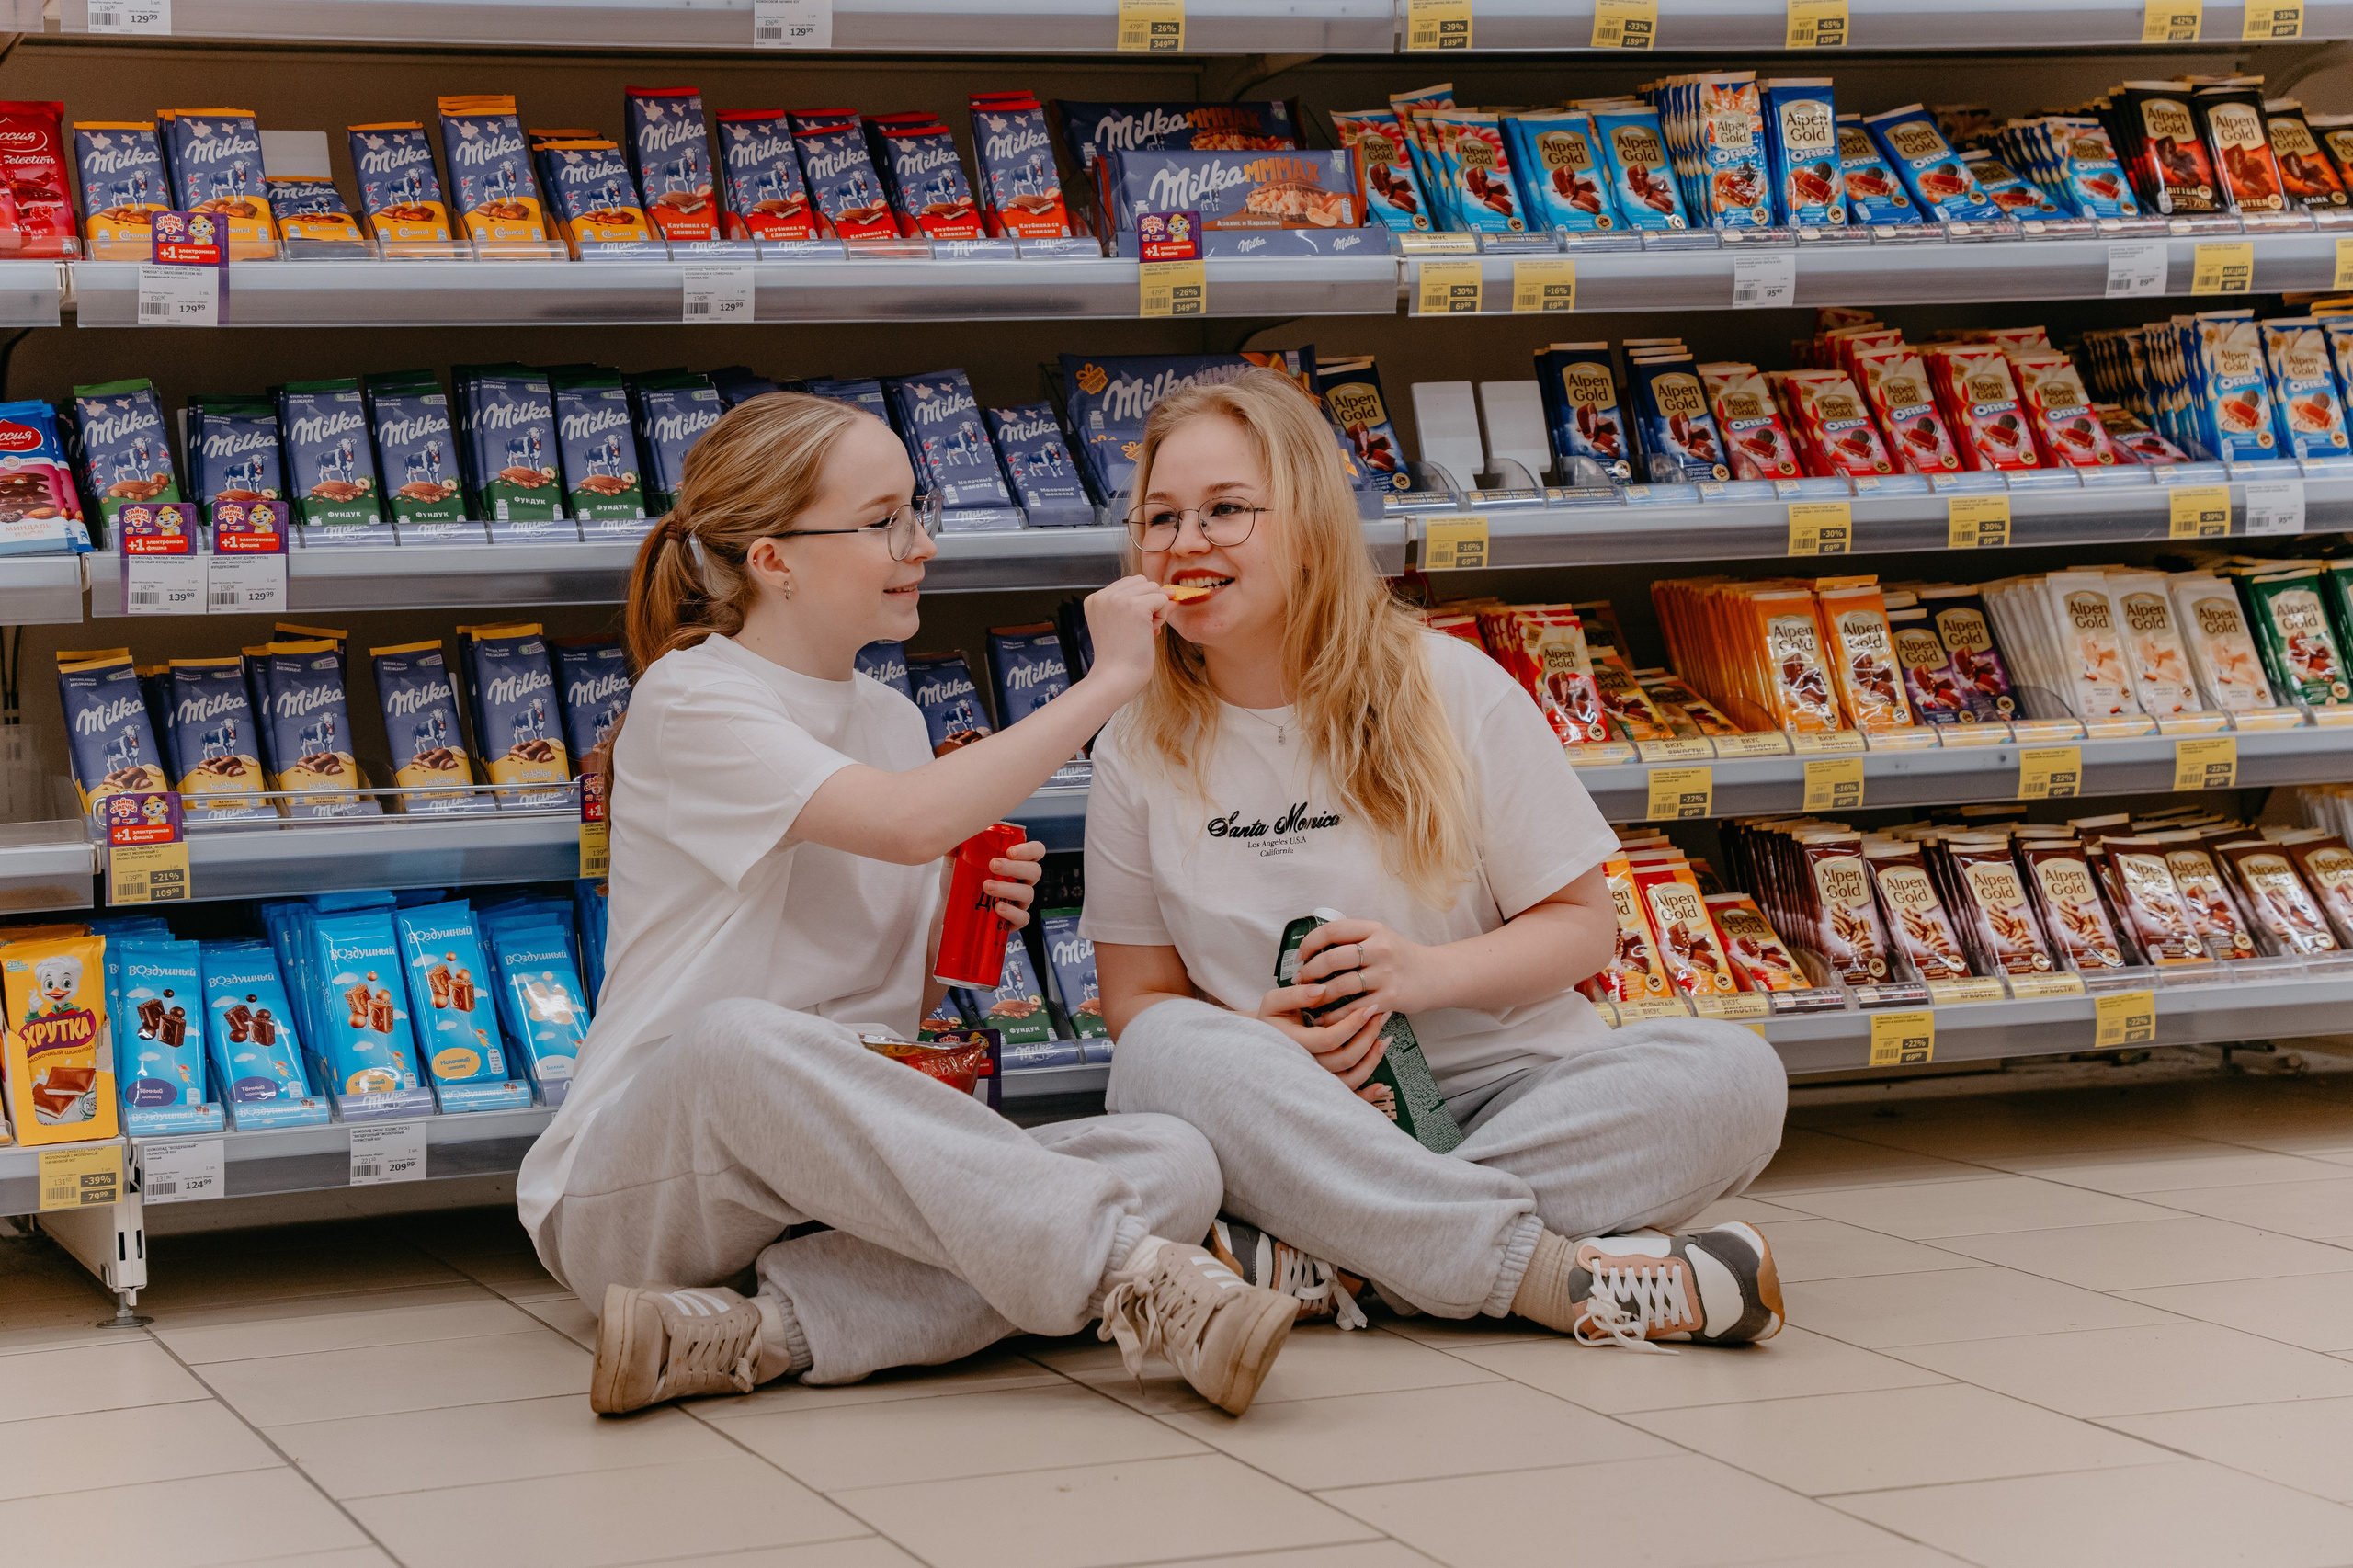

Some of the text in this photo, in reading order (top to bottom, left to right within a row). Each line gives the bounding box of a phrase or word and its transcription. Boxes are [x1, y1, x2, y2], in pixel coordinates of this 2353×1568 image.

[1785, 111, 1828, 129] Alpen
[2147, 109, 2187, 125] Alpen
[2215, 114, 2254, 129] Alpen
[639, 119, 707, 152] Milka
[1095, 108, 1190, 151] Milka
[1790, 127, 1826, 142] Gold
[1893, 128, 1933, 143] Alpen
[2154, 122, 2187, 135] Gold
[2222, 127, 2254, 142] Gold
[455, 135, 524, 165] Milka
[985, 130, 1050, 160] Milka
[1364, 139, 1393, 154] Alpen
[1542, 139, 1586, 156] Alpen
[1616, 134, 1658, 150] Alpen
[1904, 140, 1938, 153] Gold
[185, 137, 258, 164] Milka
[729, 137, 795, 167] Milka
[1368, 150, 1394, 162] Gold
[1548, 151, 1585, 165] Gold
[1623, 147, 1658, 164] Gold
[1715, 147, 1758, 163] OREO
[1791, 147, 1833, 162] OREO
[84, 146, 160, 173] Milka
[361, 146, 431, 174] Milka
[807, 148, 870, 179] Milka
[896, 149, 960, 176] Milka
[1911, 151, 1950, 168] OREO
[561, 161, 627, 183] Milka
[1149, 158, 1246, 210] Milka
[1238, 235, 1267, 252] Milka
[2221, 351, 2249, 361] Alpen
[2223, 361, 2248, 371] Gold
[1569, 373, 1608, 390] Alpen
[1972, 382, 2002, 393] Alpen
[2221, 376, 2260, 390] OREO
[2290, 378, 2330, 391] OREO
[1574, 387, 1608, 403] Gold
[1659, 383, 1699, 400] Alpen
[1976, 390, 2003, 401] Gold
[915, 395, 975, 424] Milka
[1334, 392, 1377, 412] Alpen
[1665, 394, 1699, 411] Gold
[1972, 402, 2017, 417] OREO
[482, 401, 551, 430] Milka
[1341, 404, 1377, 421] Gold
[1893, 404, 1931, 421] OREO
[85, 411, 158, 446] Milka
[292, 411, 365, 445] Milka
[379, 415, 449, 447] Milka
[561, 409, 630, 440] Milka
[998, 418, 1059, 441] Milka
[1730, 416, 1775, 431] OREO
[202, 432, 278, 458] Milka
[2071, 602, 2109, 615] Alpen
[2127, 604, 2165, 617] Alpen
[2199, 608, 2237, 622] Alpen
[1942, 619, 1982, 636] Alpen
[2075, 614, 2109, 629] Gold
[2132, 615, 2165, 630] Gold
[2205, 619, 2237, 634] Gold
[1775, 625, 1814, 641] Alpen
[1949, 632, 1983, 646] Gold
[1899, 638, 1938, 653] Alpen
[1544, 648, 1574, 660] Alpen
[1905, 650, 1939, 664] Gold
[1549, 657, 1574, 668] Gold
[1006, 659, 1067, 690] Milka
[487, 670, 551, 705] Milka
[568, 672, 631, 707] Milka
[917, 678, 976, 706] Milka
[276, 684, 345, 717] Milka
[386, 681, 452, 716] Milka
[75, 697, 145, 735] Milka
[177, 692, 247, 725] Milka
[1823, 869, 1862, 884] Alpen
[1887, 877, 1927, 892] Alpen
[1975, 874, 2015, 889] Alpen
[2045, 869, 2086, 884] Alpen
[1827, 883, 1860, 897] Gold
[1893, 890, 1928, 903] Gold
[1982, 885, 2016, 900] Gold
[2052, 882, 2086, 896] Gold
[1655, 892, 1696, 908] Alpen
[1662, 906, 1698, 920] Gold
[23, 1016, 92, 1050] ХРУТКА
